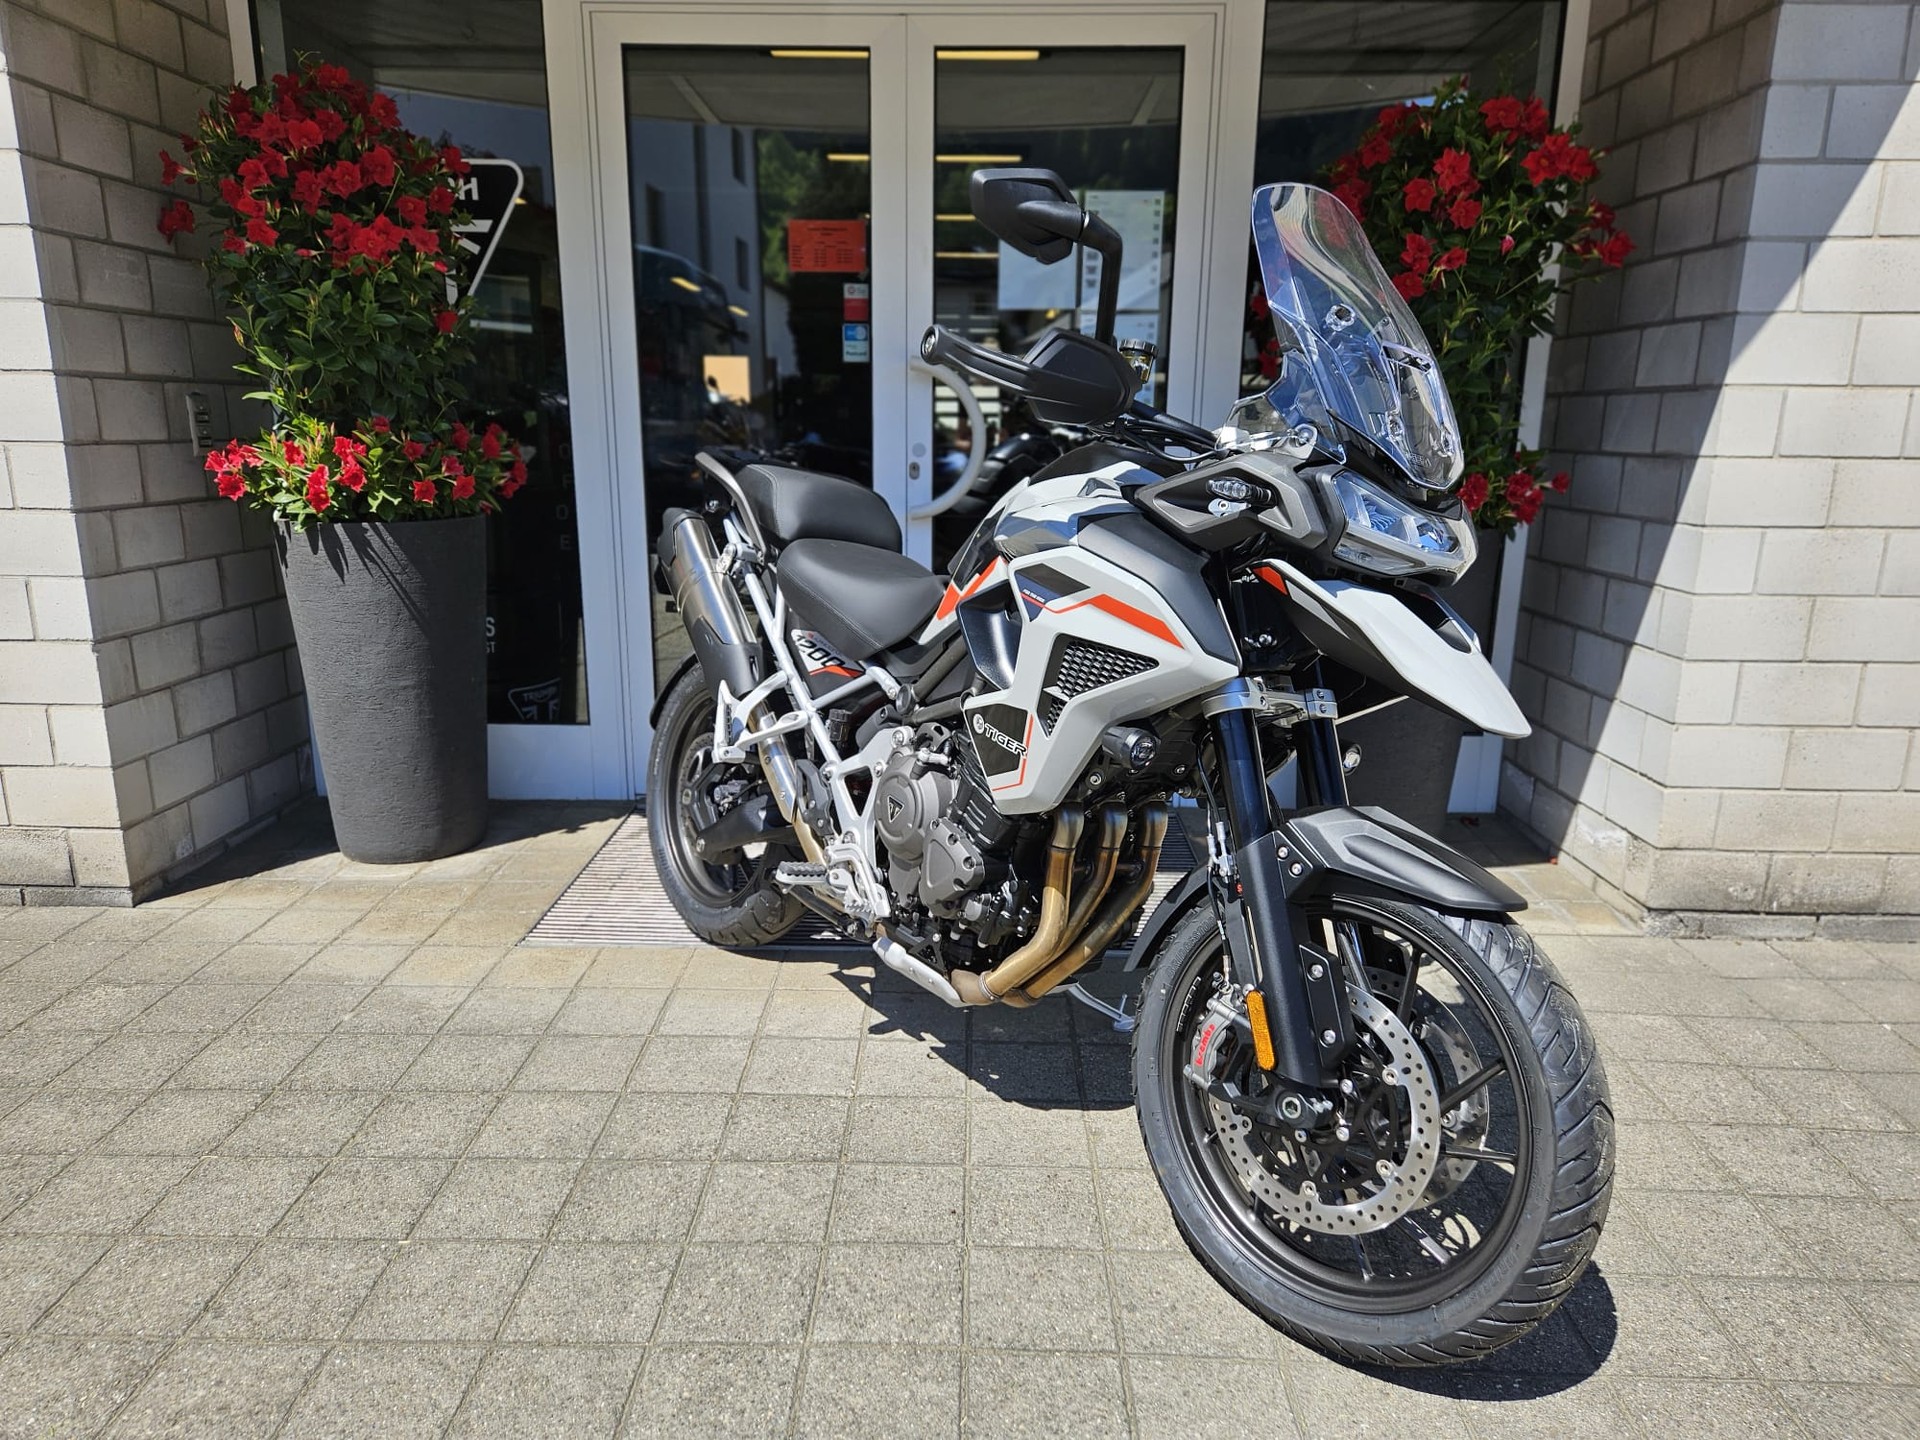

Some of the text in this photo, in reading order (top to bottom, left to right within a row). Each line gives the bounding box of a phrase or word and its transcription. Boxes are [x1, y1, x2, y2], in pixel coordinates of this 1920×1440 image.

[796, 634, 846, 668] 1200
[985, 723, 1028, 758] TIGER
[1194, 1023, 1217, 1067] brembo
